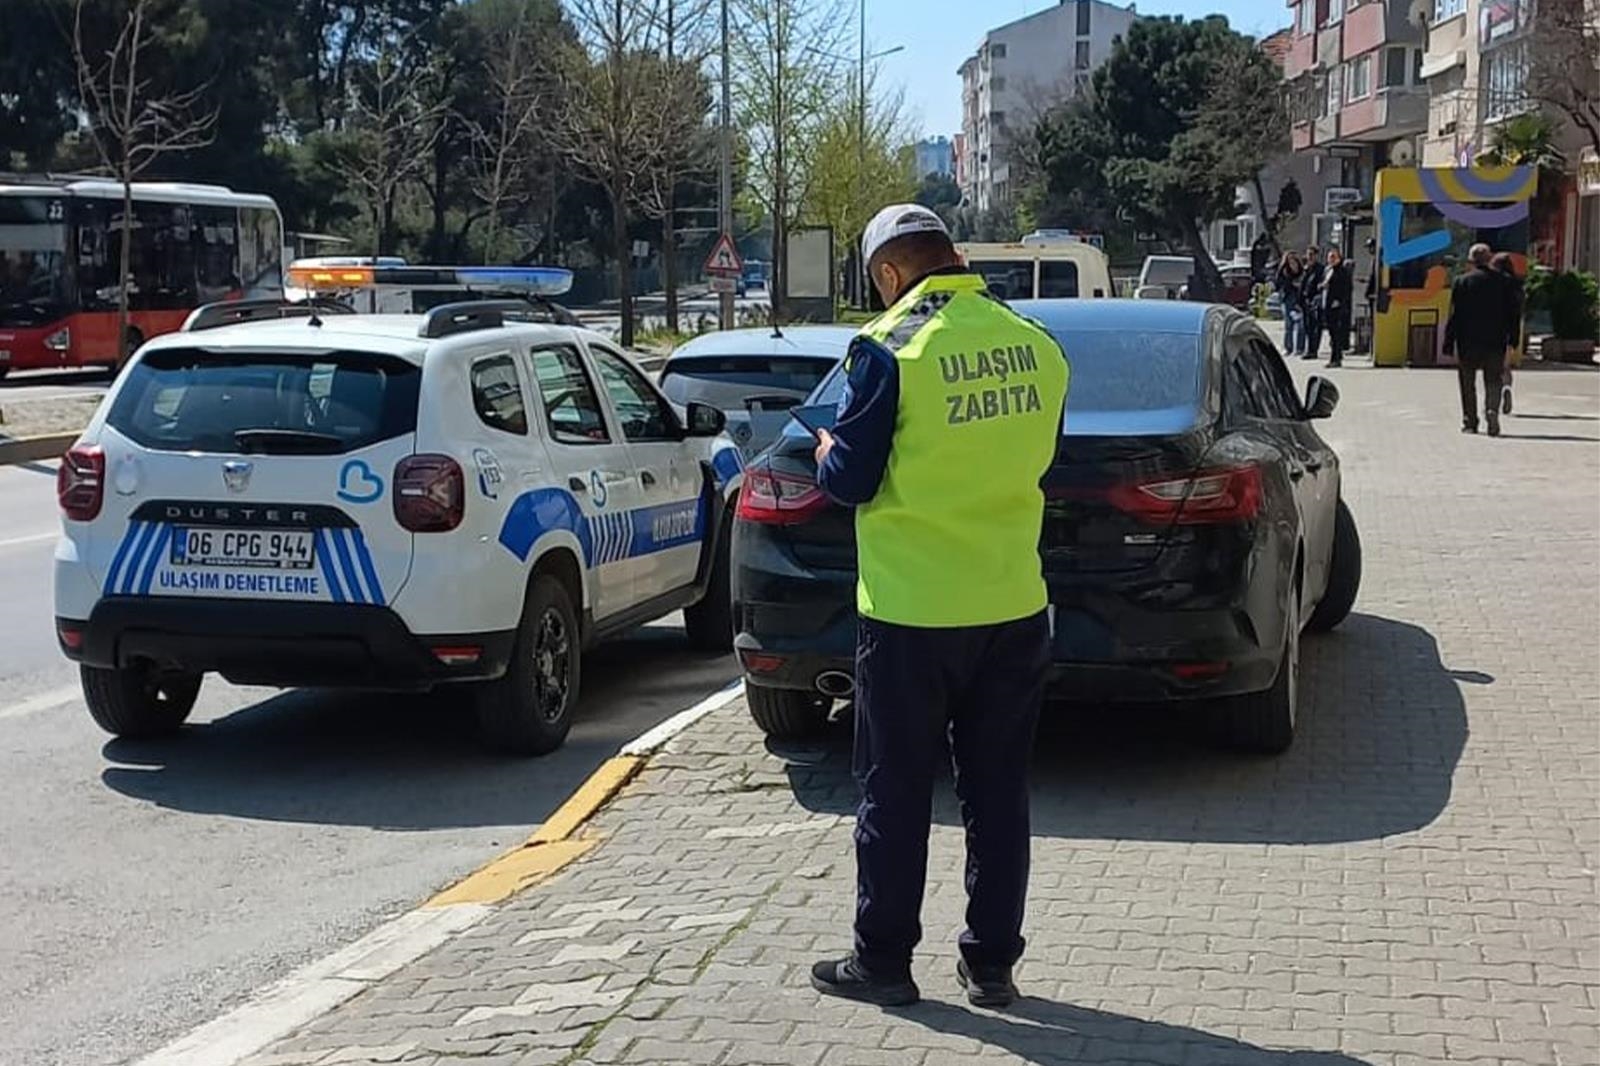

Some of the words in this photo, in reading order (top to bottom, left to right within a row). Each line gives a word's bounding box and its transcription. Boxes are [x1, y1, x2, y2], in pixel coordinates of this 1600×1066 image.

[939, 344, 1038, 383] ULAŞIM
[946, 384, 1041, 424] ZABITA
[166, 506, 307, 521] DUSTER
[188, 532, 213, 556] 06
[222, 532, 262, 557] CPG
[270, 534, 307, 559] 944
[160, 571, 219, 593] ULAŞIM
[224, 574, 319, 594] DENETLEME
